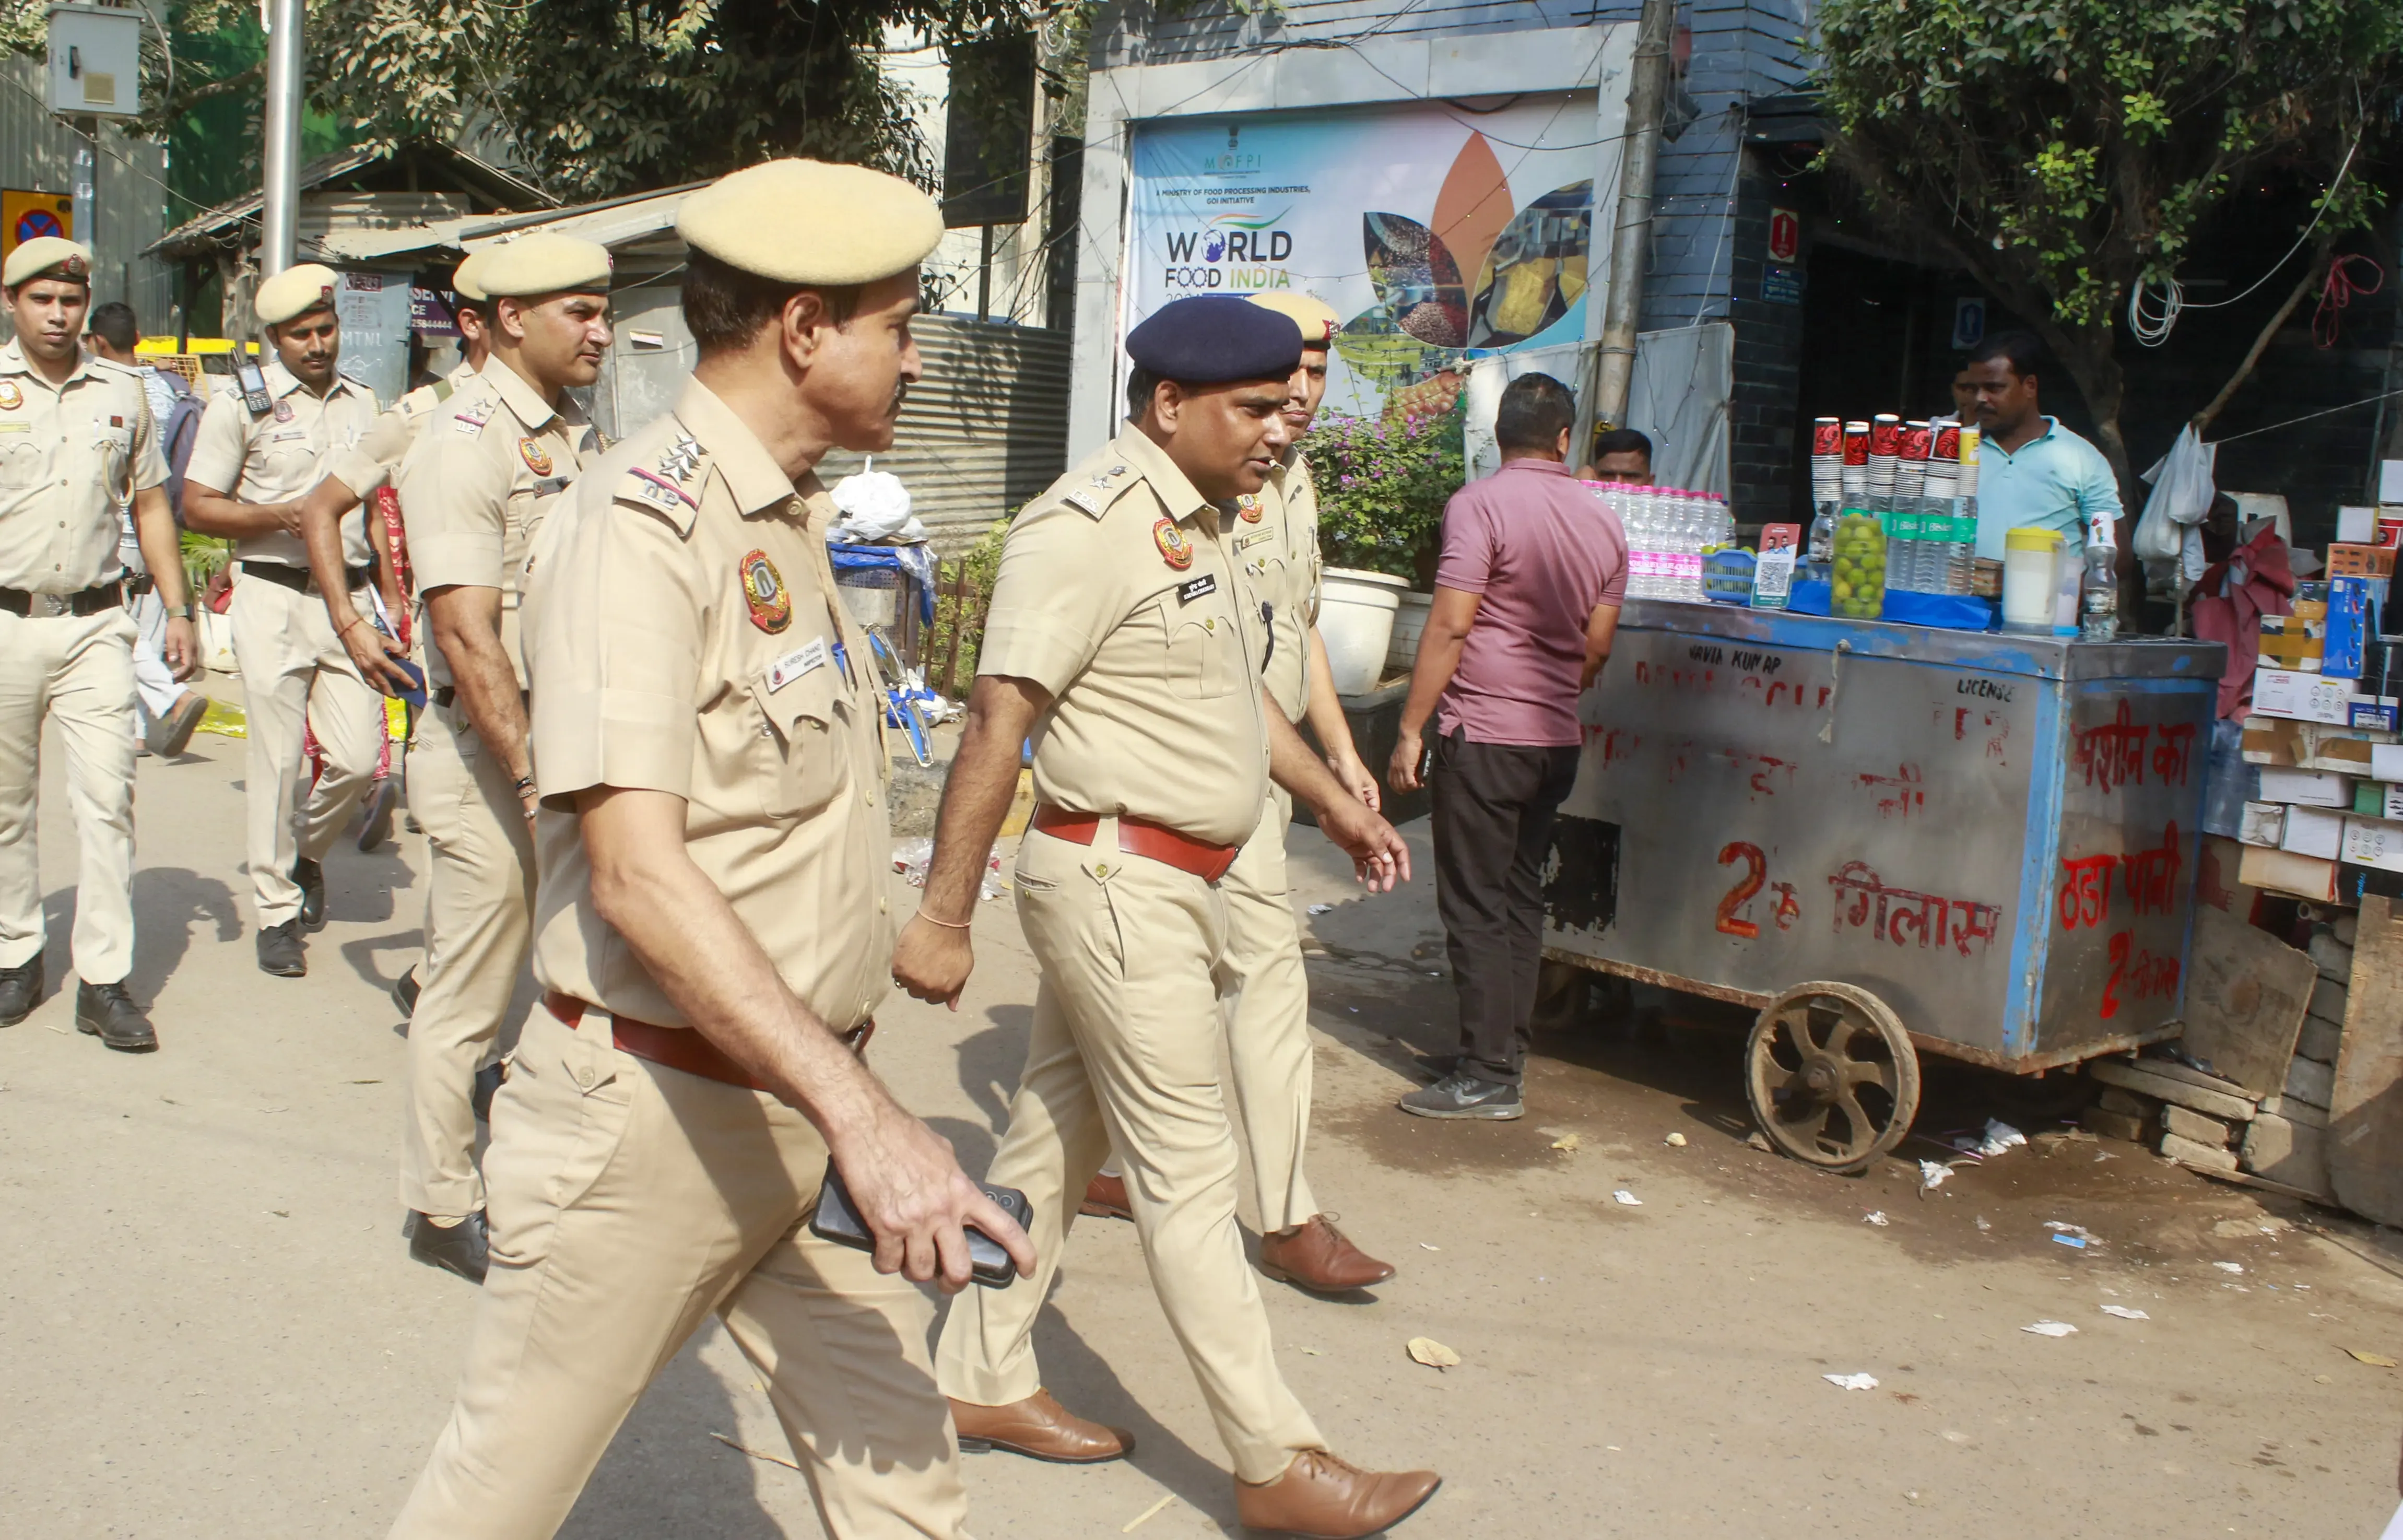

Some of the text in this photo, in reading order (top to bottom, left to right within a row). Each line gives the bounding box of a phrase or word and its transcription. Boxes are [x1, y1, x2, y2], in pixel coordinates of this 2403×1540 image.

[1224, 187, 1266, 195] PROCESSING
[1166, 230, 1292, 262] WORLD
[1165, 266, 1290, 288] FOOD INDIA
[1828, 861, 2002, 958] गिलास
